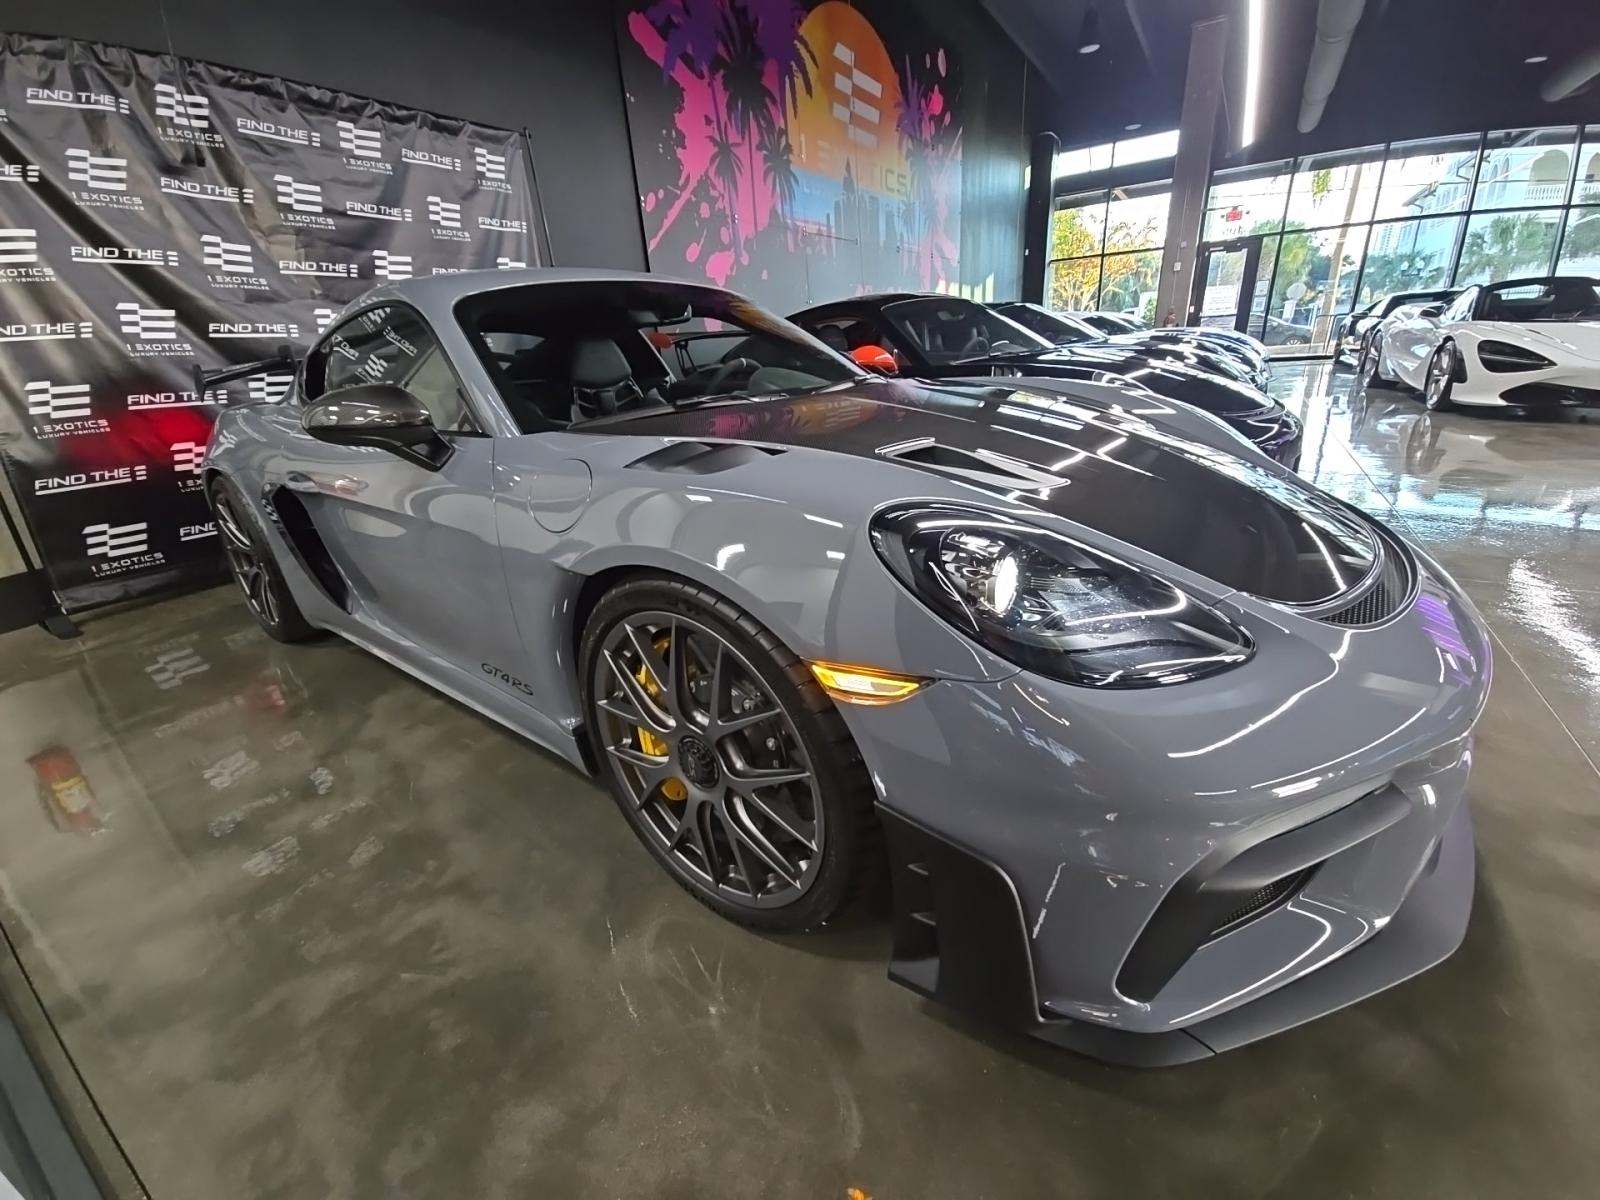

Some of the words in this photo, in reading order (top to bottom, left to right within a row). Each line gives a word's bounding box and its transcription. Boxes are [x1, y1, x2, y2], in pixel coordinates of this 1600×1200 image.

[27, 88, 73, 101] FIND
[77, 92, 115, 105] THE
[167, 127, 222, 141] EXOTICS
[237, 117, 275, 133] FIND
[277, 125, 308, 140] THE
[402, 148, 429, 160] FIND
[431, 153, 452, 165] THE
[0, 165, 22, 176] HE
[161, 177, 200, 192] FIND
[203, 184, 239, 197] THE
[81, 193, 142, 204] EXOTICS
[346, 201, 377, 213] FIND
[379, 206, 401, 216] THE
[287, 214, 334, 224] EXOTICS
[479, 216, 500, 226] FIND
[501, 220, 521, 228] THE
[71, 246, 119, 258] FIND
[123, 248, 163, 260] THE
[279, 260, 316, 271] FIND
[319, 262, 347, 273] THE
[217, 276, 267, 285] EXOTICS
[31, 323, 75, 334] THE
[209, 323, 251, 333] FIND
[255, 324, 286, 333] THE
[127, 393, 175, 405] FIND
[44, 419, 109, 433] EXOTICS
[34, 473, 86, 490] FIND
[90, 467, 131, 481] THE
[101, 552, 163, 570] EXOTICS
